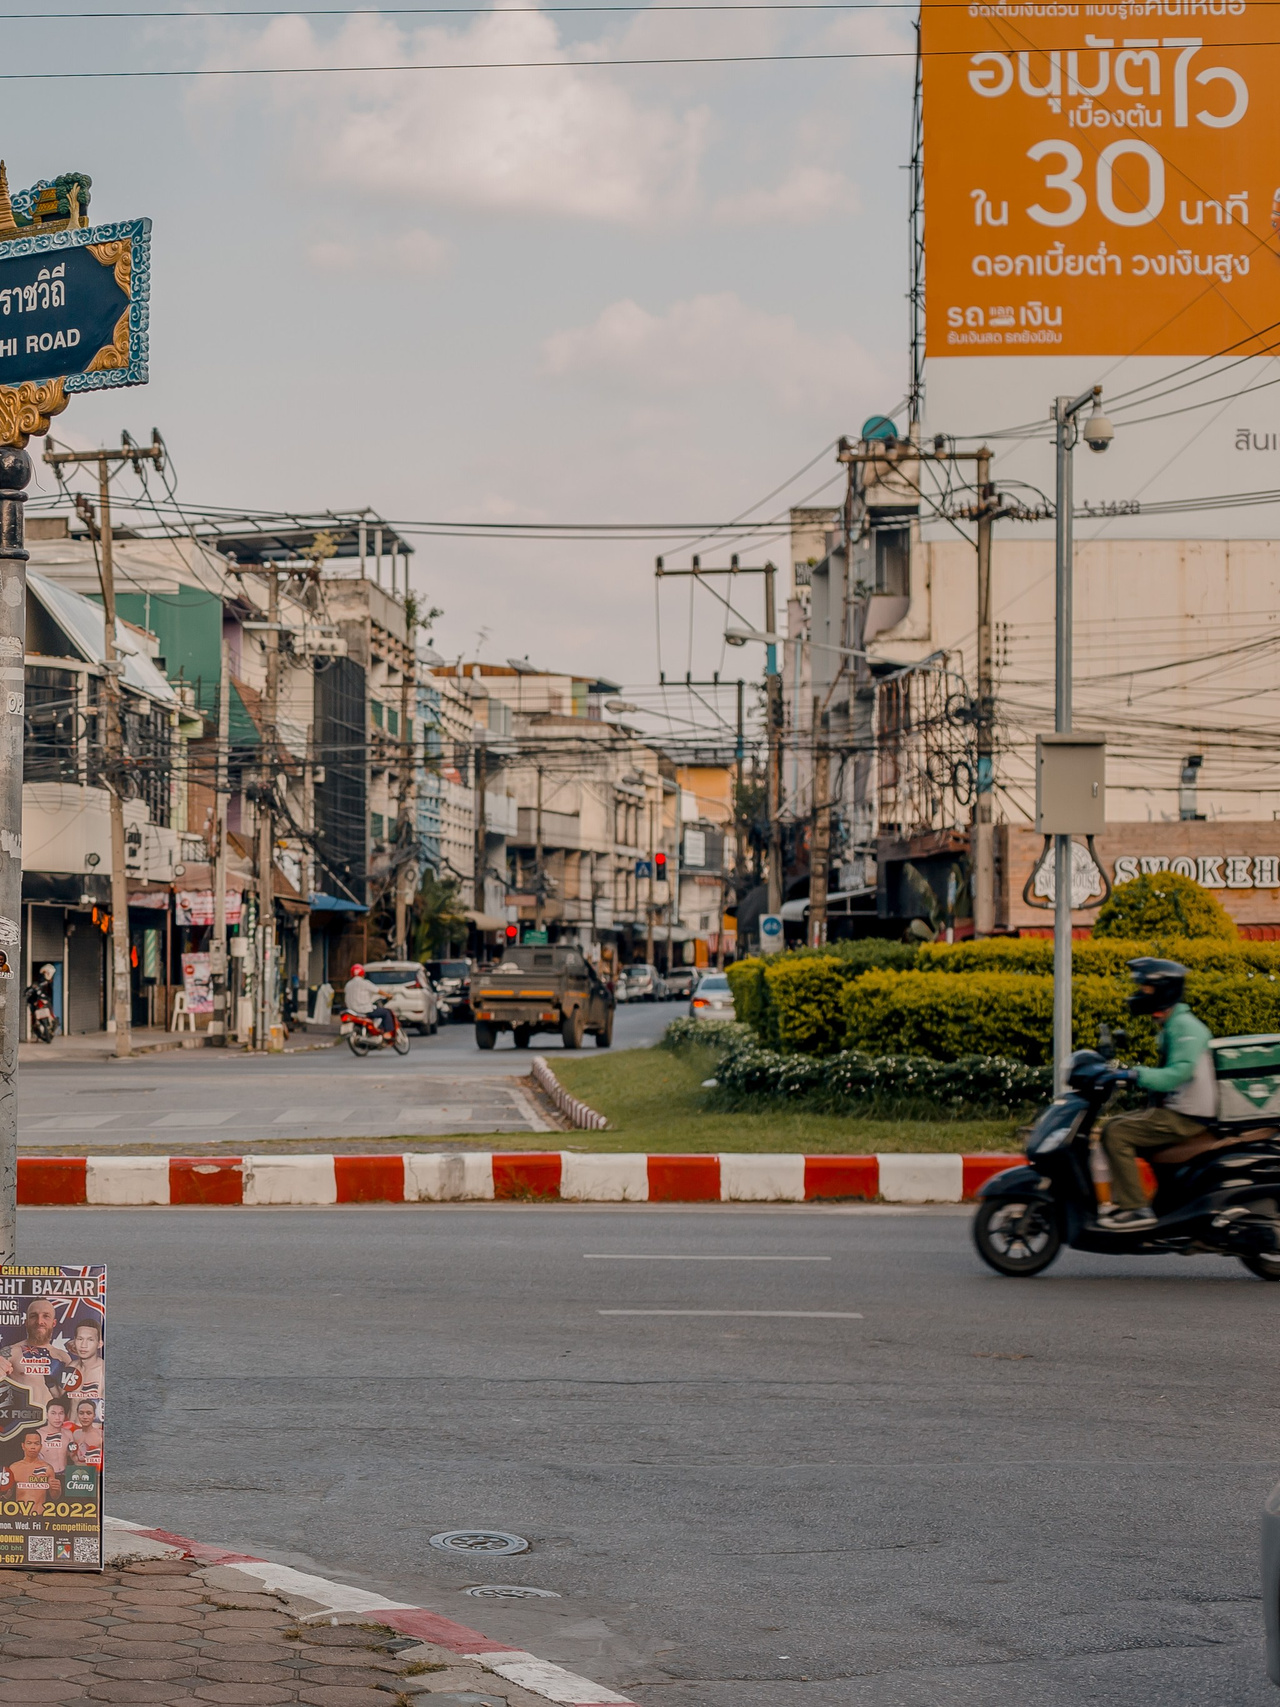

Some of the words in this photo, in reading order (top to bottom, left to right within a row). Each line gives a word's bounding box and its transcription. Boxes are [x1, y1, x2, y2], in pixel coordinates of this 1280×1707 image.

[1070, 98, 1162, 128] เบื้องต้น
[970, 189, 1008, 226] ใน
[1026, 139, 1165, 227] 30
[1179, 191, 1248, 225] นาที
[972, 241, 1121, 277] ดอกเบี้ยต่ำ
[1132, 249, 1250, 283] วงเงินสูง
[947, 305, 985, 327] รถ
[1020, 301, 1063, 327] เงิน
[26, 328, 81, 354] ROAD
[2, 1266, 61, 1276] CHIANGMAI
[32, 1280, 95, 1296] BAZAAR
[61, 1371, 79, 1386] VS
[11, 1410, 43, 1419] FIGHT
[66, 1481, 94, 1491] Chang
[43, 1502, 97, 1518] 2022
[15, 1522, 30, 1530] Wed.
[32, 1522, 41, 1530] Fri
[45, 1522, 50, 1531] 7
